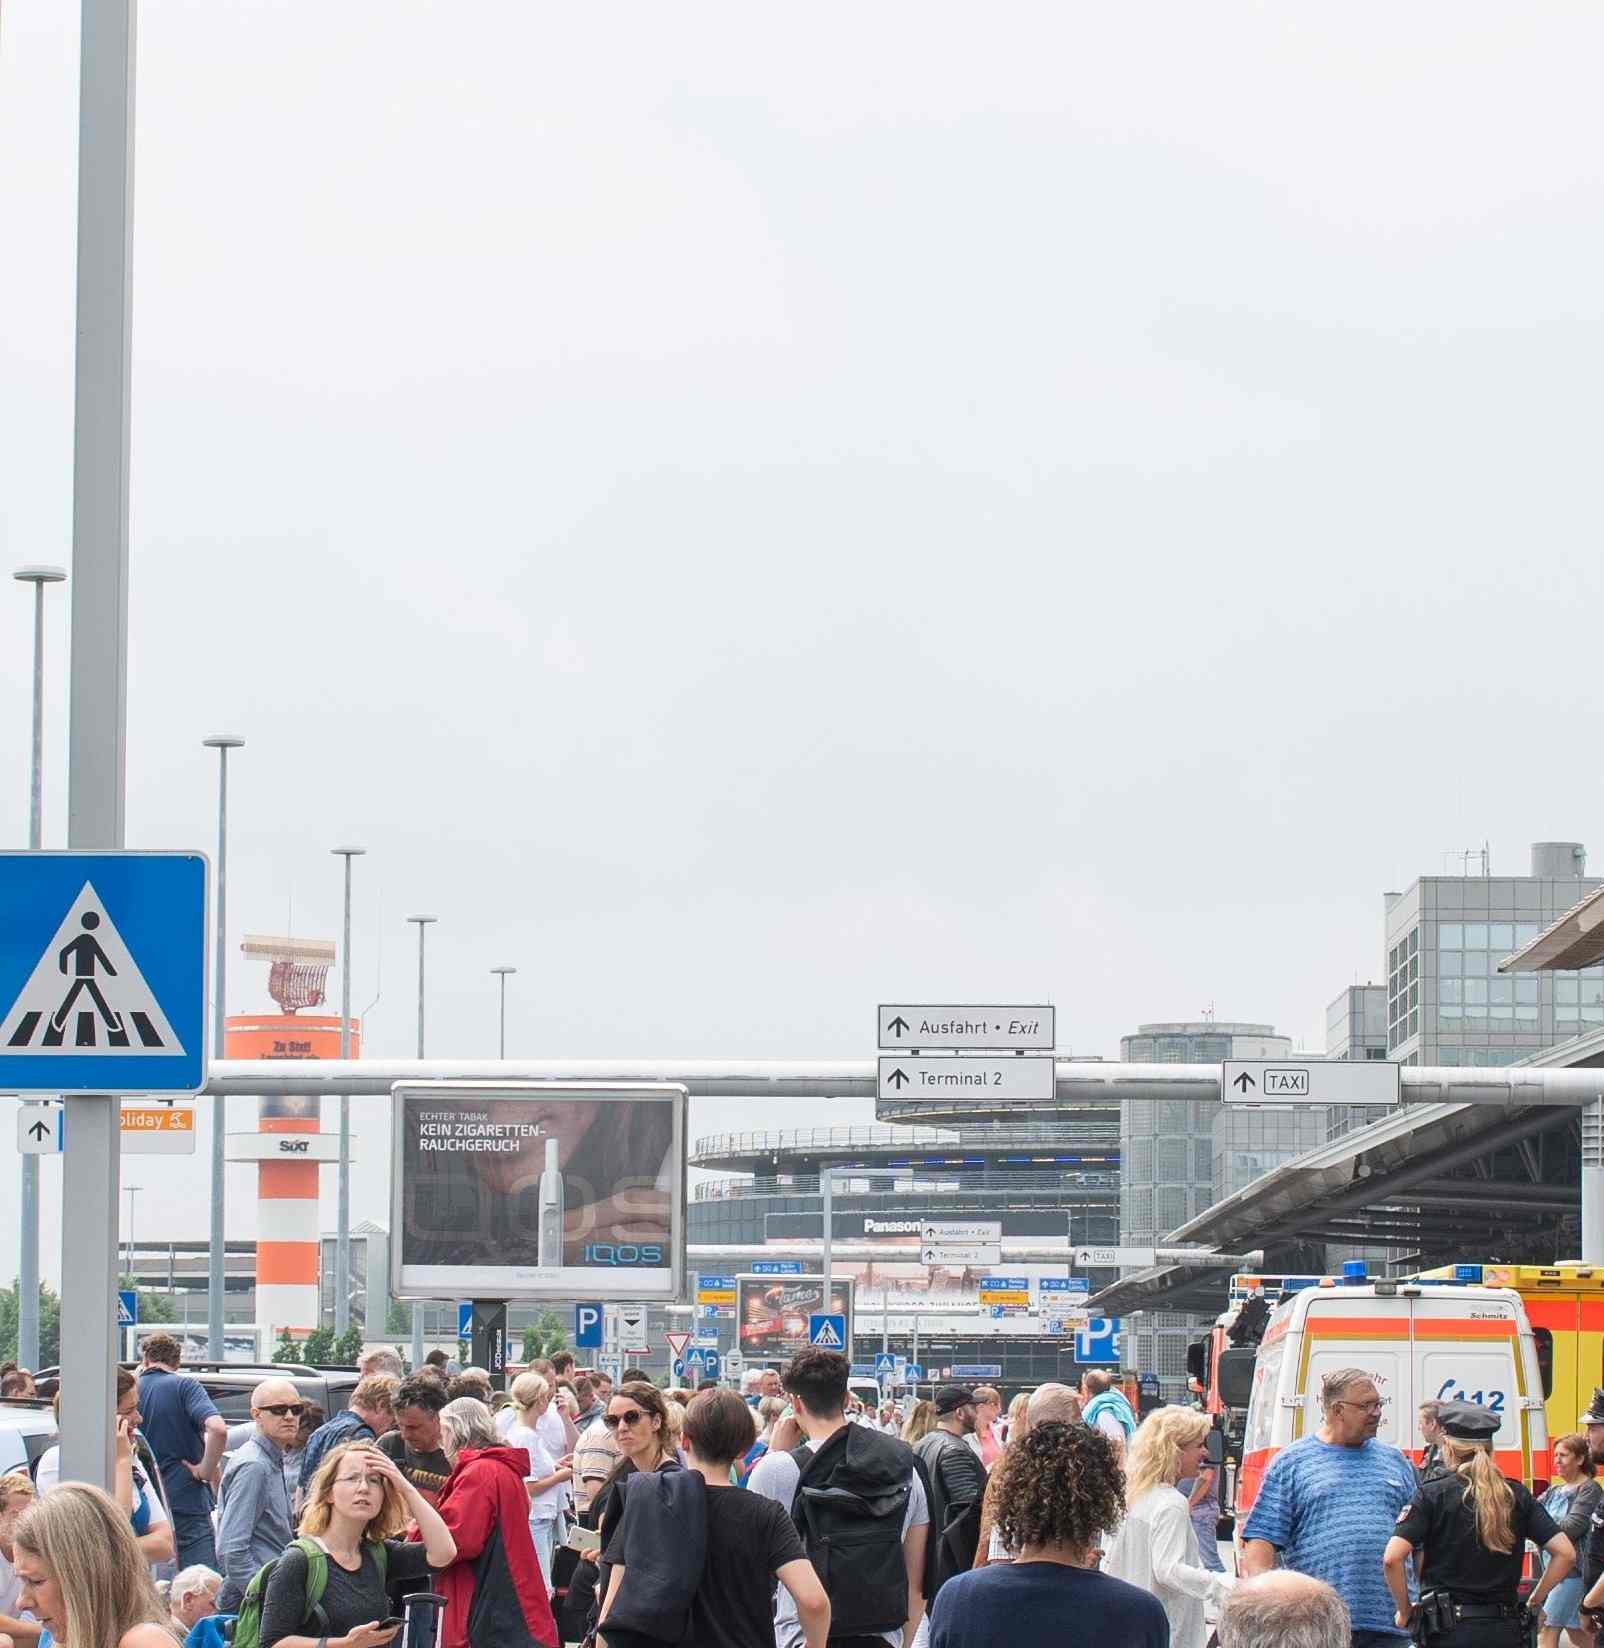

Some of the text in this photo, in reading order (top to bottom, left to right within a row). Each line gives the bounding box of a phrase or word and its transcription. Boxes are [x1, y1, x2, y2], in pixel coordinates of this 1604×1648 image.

[919, 1020, 1040, 1035] Ausfahrt Exit
[919, 1071, 1003, 1086] Terminal 2
[1269, 1075, 1304, 1090] TAXI
[120, 1111, 163, 1133] oliday
[420, 1124, 546, 1137] KEIN ZIGARETTEN-
[419, 1138, 520, 1152] RAUCHGERUCH
[864, 1219, 925, 1233] Panason
[584, 1246, 662, 1265] IQOS
[579, 1308, 598, 1335] P
